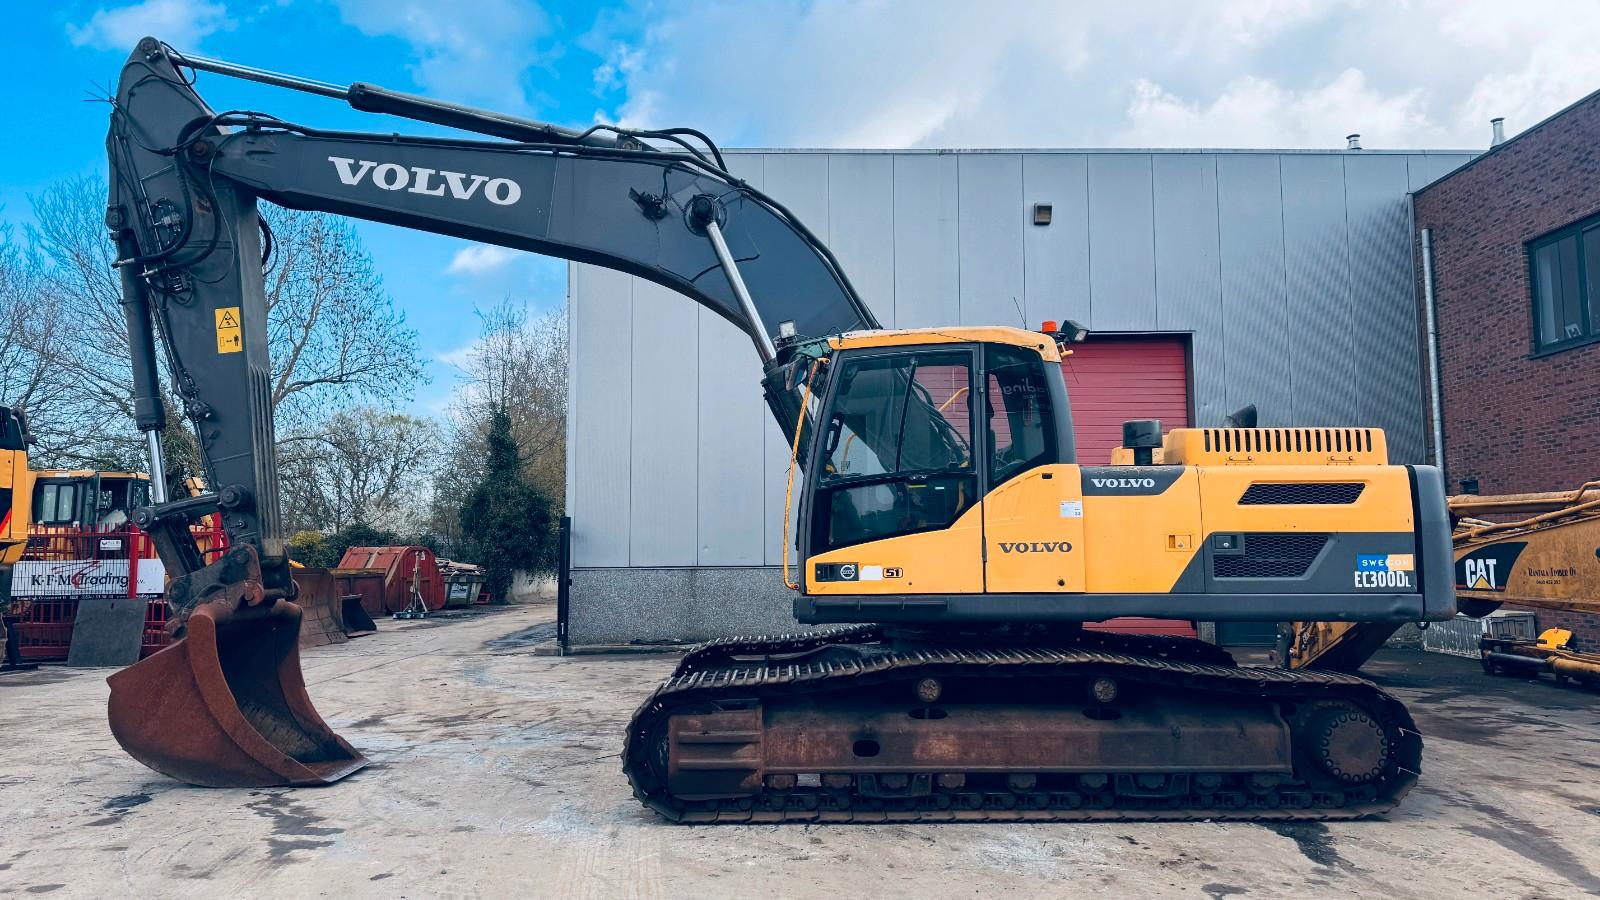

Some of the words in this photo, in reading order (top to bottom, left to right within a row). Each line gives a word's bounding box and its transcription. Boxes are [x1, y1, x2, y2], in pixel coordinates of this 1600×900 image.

[328, 156, 522, 206] VOLVO
[1091, 478, 1155, 488] VOLVO
[998, 541, 1073, 554] VOLVO
[79, 572, 129, 588] Trading
[1354, 570, 1411, 588] EC300DL
[1465, 558, 1497, 590] CAT
